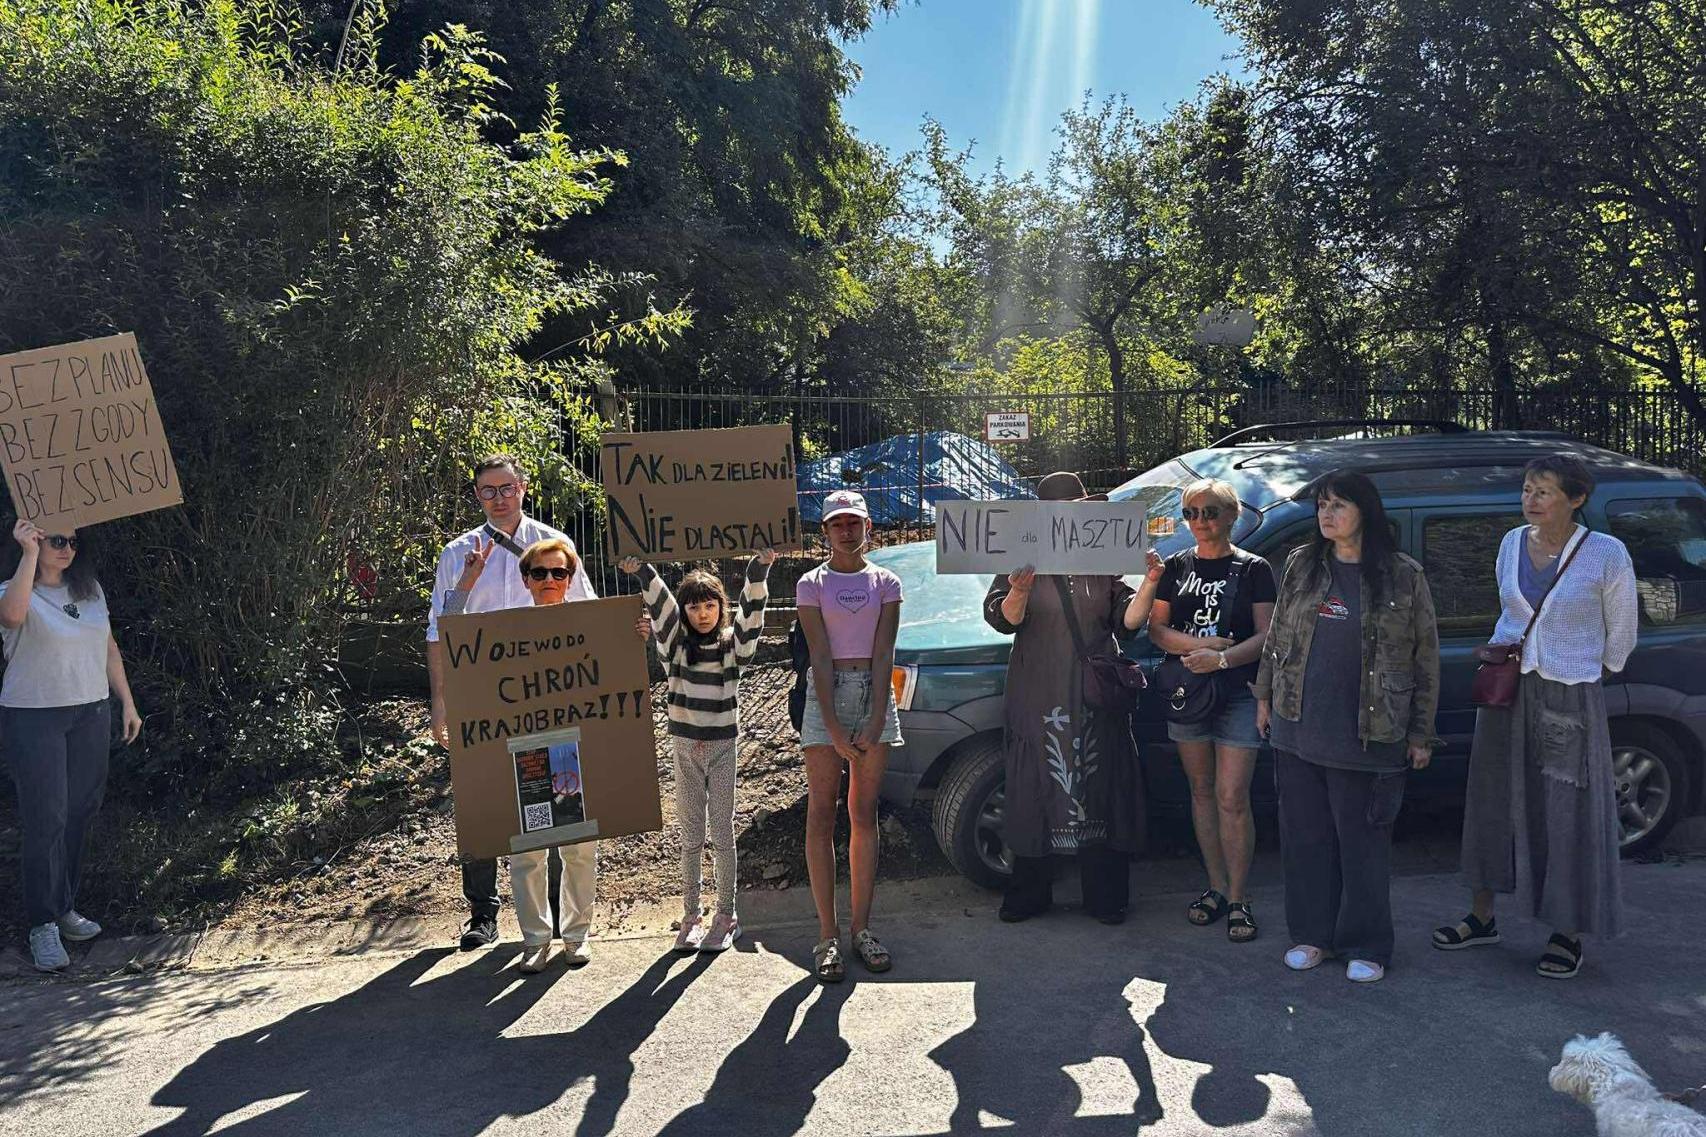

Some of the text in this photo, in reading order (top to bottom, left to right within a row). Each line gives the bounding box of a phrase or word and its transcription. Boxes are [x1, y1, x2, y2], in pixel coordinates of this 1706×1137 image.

[68, 347, 143, 398] PLANU
[0, 398, 149, 464] BEZ ZGODY
[14, 447, 169, 520] BEZ SENSU
[602, 442, 667, 486] TAK
[673, 462, 707, 484] DLA
[942, 508, 1144, 554] NIE dla MASZTU
[1205, 594, 1219, 608] IS
[445, 628, 585, 669] WOJEWODO
[498, 653, 599, 704] CHROŃ
[461, 690, 644, 748] KRAJOBRAZ!!!
